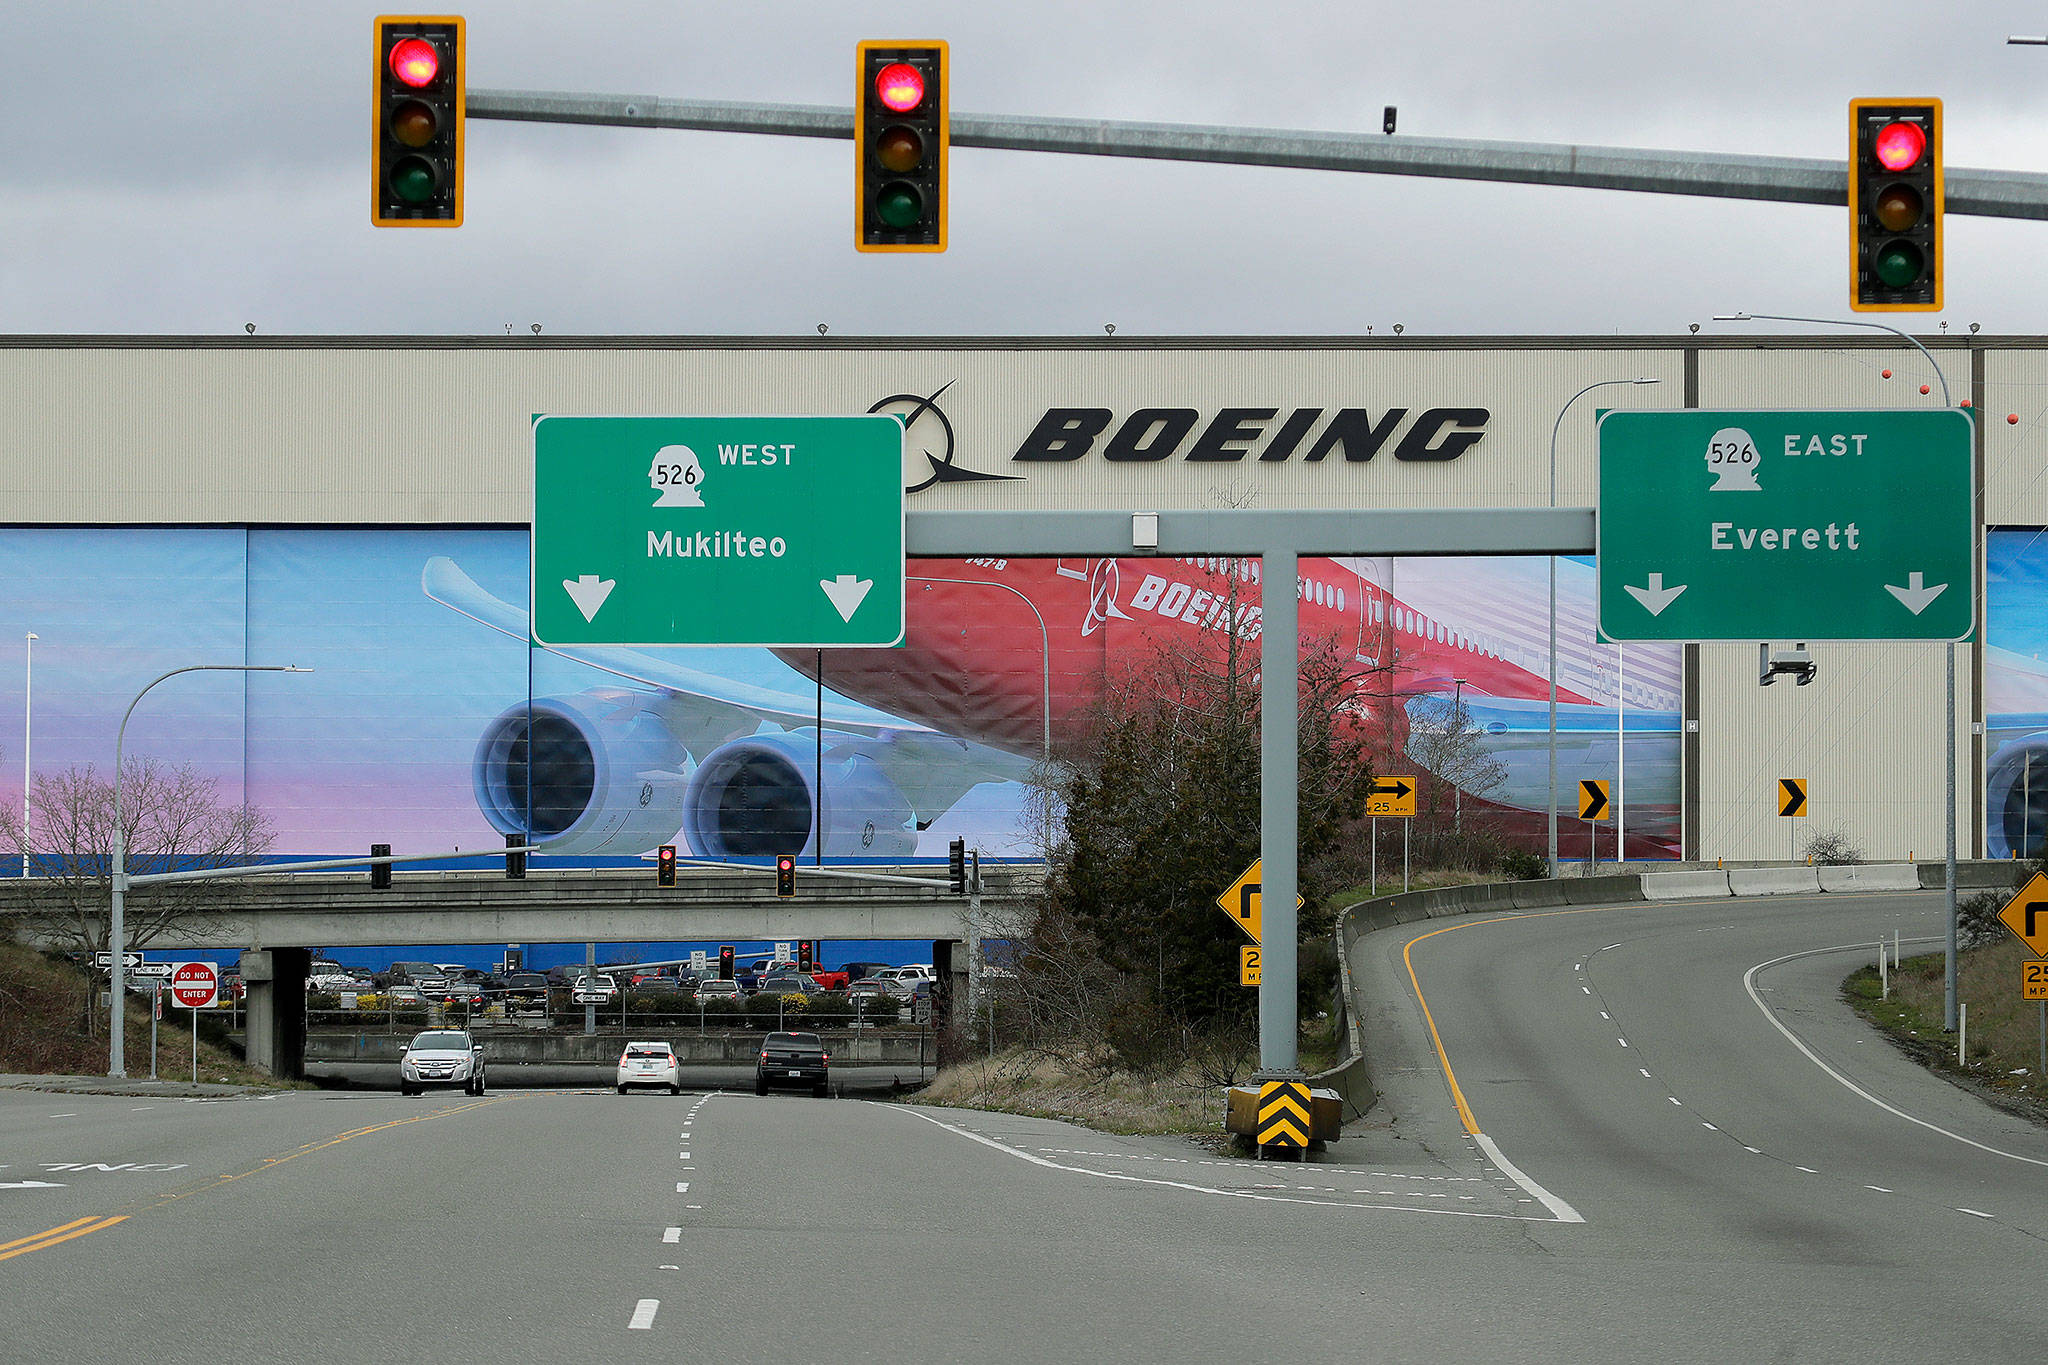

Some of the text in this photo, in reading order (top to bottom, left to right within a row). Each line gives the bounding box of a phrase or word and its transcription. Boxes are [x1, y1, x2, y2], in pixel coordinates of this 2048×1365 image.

[1011, 408, 1491, 462] BOEING
[1784, 434, 1868, 456] EAST
[718, 444, 795, 465] WEST
[1711, 443, 1753, 464] 526
[656, 464, 696, 485] 526
[647, 531, 786, 558] Mukilteo
[1711, 522, 1860, 550] Everett
[1130, 574, 1262, 640] BOEING
[1374, 802, 1390, 812] 25
[1246, 951, 1260, 968] 2
[180, 972, 209, 980] DO NOT
